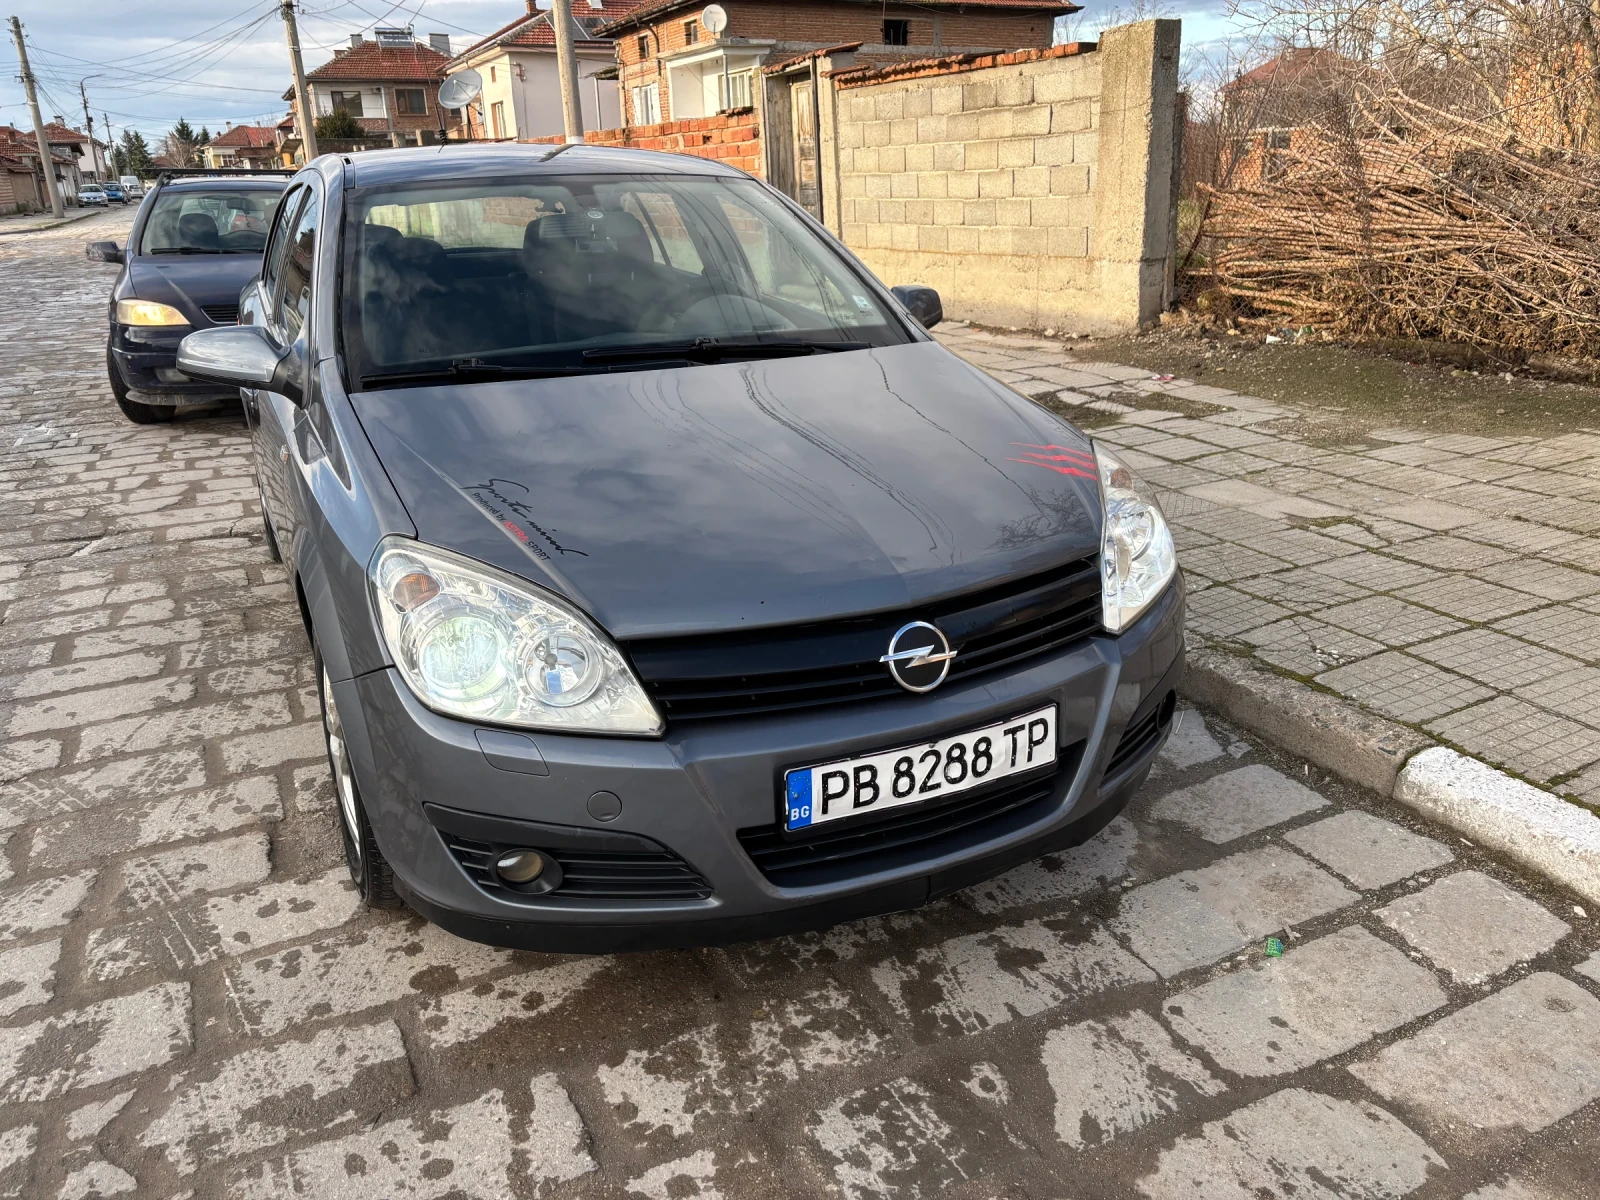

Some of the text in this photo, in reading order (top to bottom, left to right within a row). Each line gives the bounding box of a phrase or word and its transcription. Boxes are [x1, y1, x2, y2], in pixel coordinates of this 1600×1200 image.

[471, 492, 551, 561] Produced by ASTRA SPORT
[820, 717, 1049, 815] PB 8288 TP
[790, 805, 810, 822] BG
